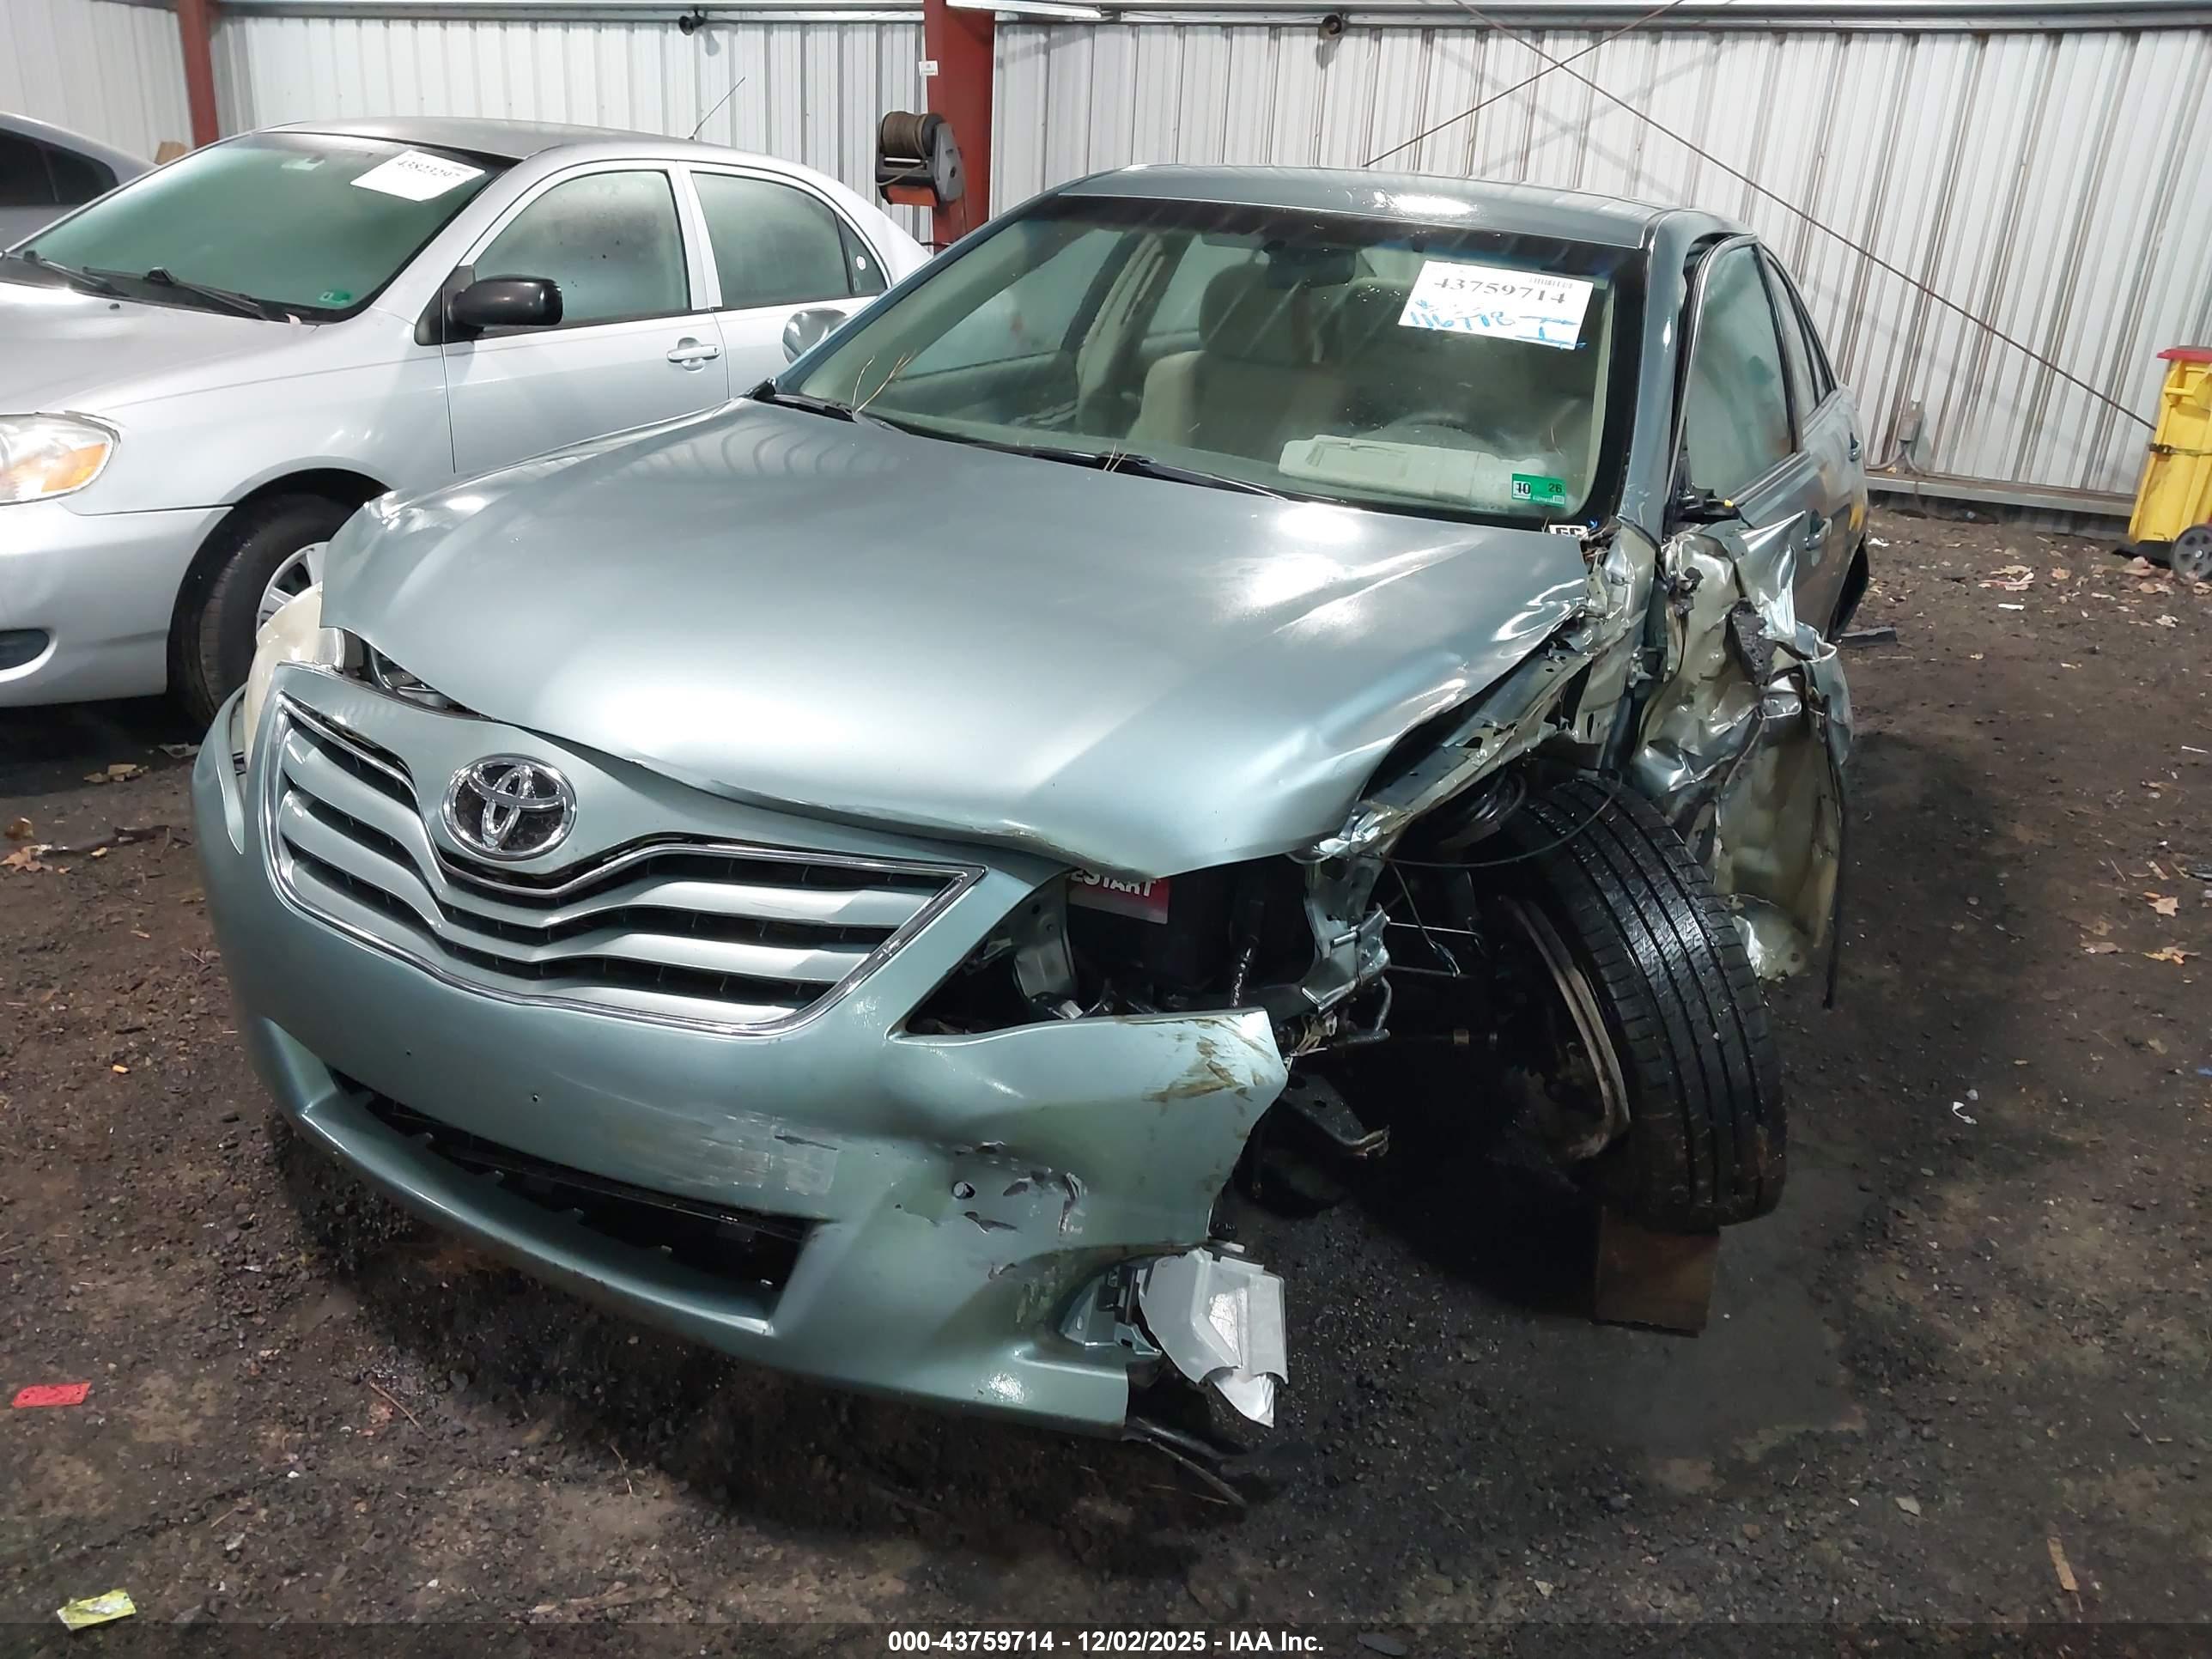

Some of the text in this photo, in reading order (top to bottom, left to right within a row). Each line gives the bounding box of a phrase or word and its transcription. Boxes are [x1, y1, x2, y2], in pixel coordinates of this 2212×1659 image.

[1433, 276, 1566, 304] 43759714
[1516, 482, 1563, 495] 10 26
